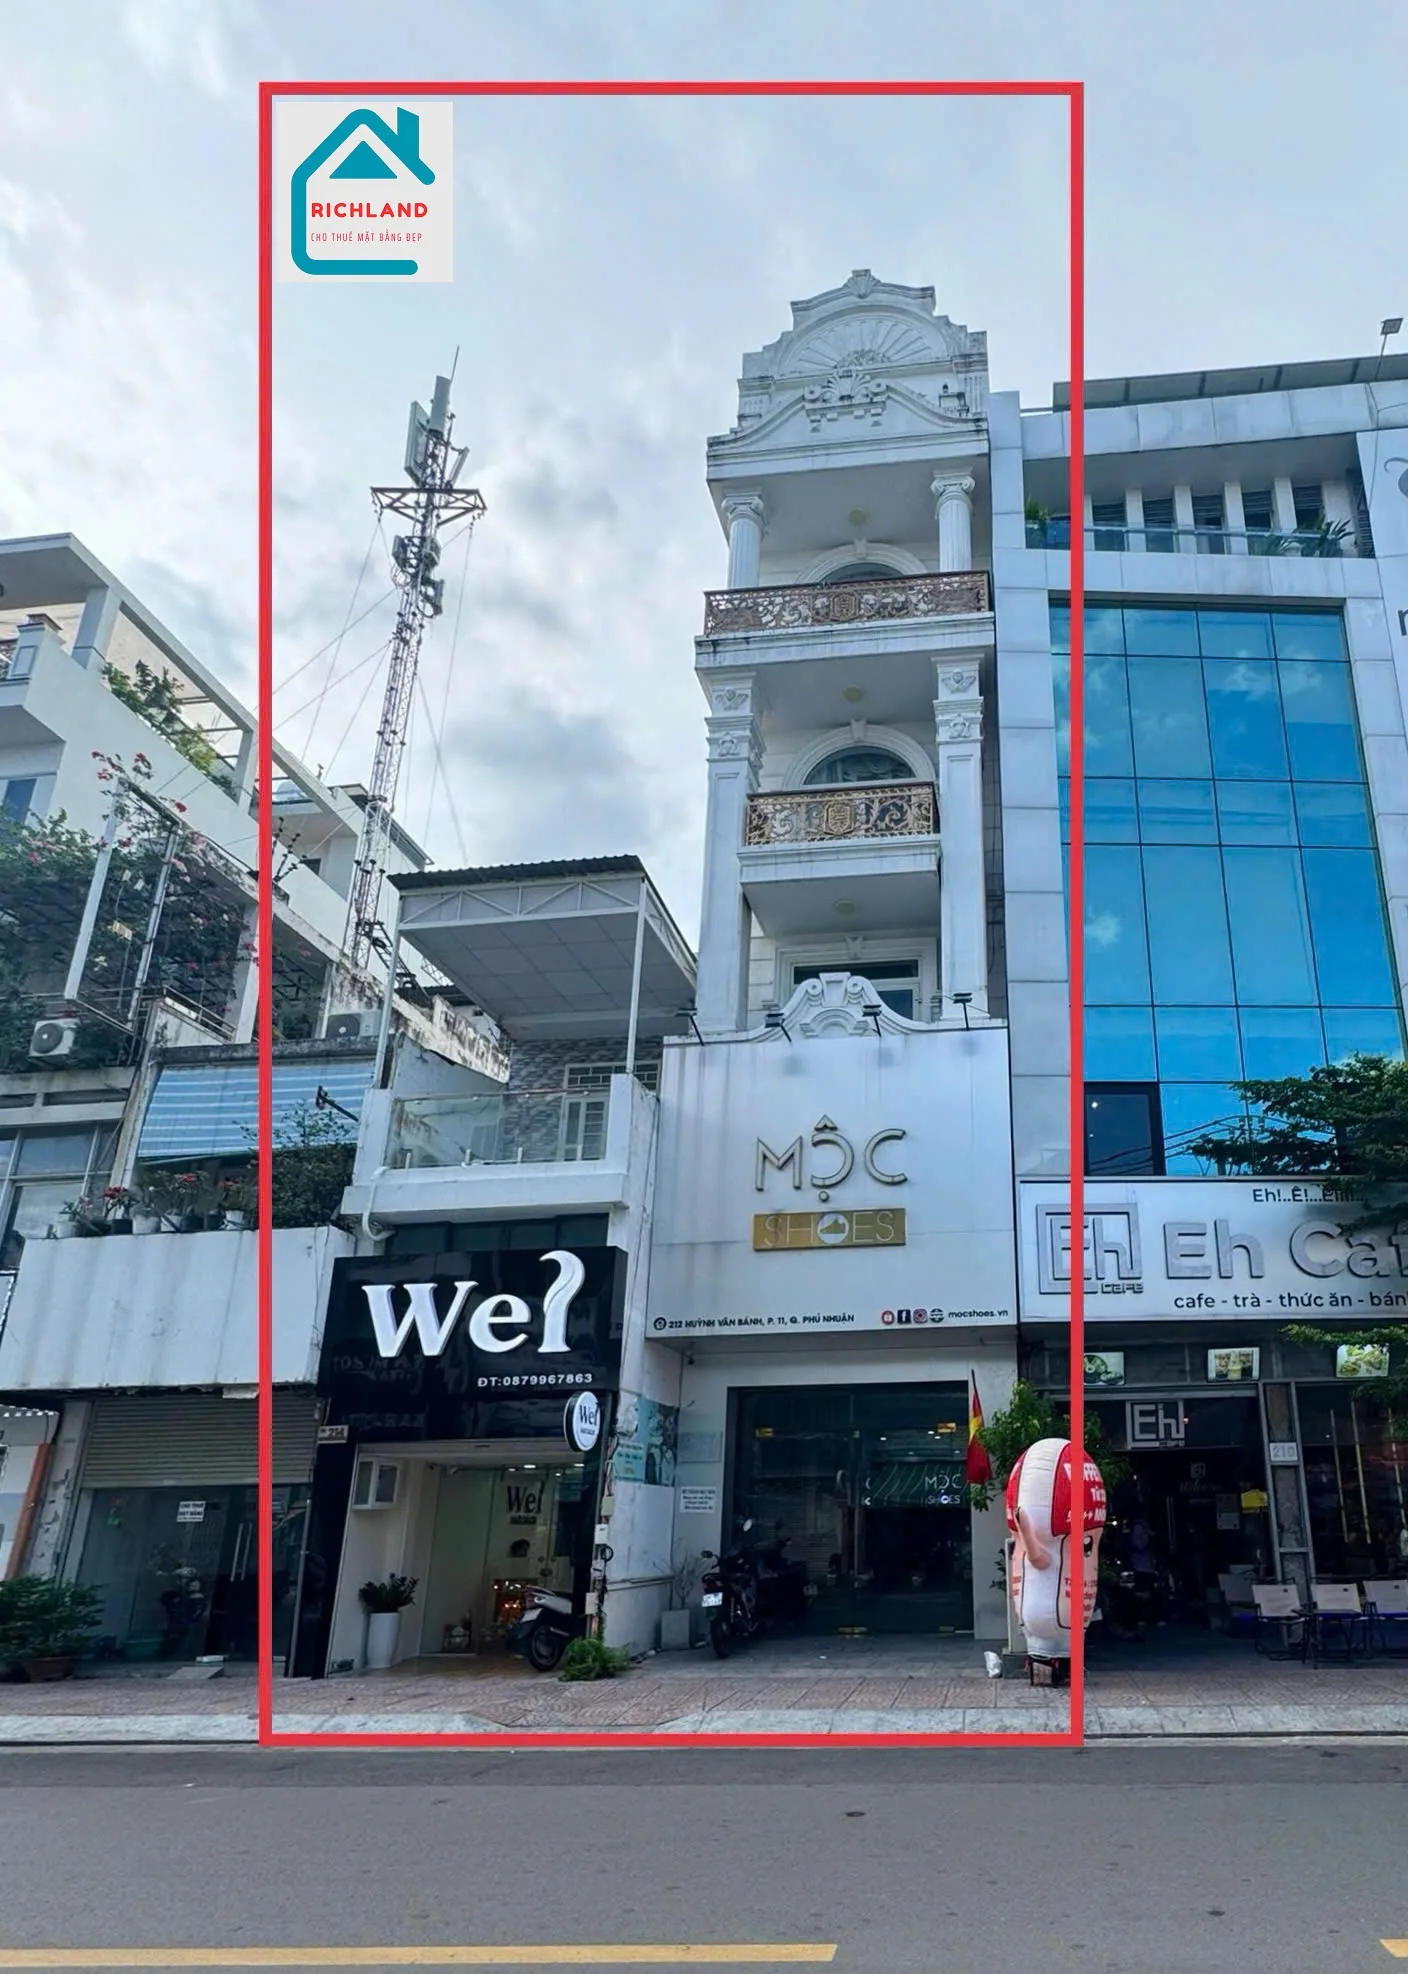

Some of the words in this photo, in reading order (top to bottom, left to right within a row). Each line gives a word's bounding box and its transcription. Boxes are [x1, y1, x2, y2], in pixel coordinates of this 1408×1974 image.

[755, 1114, 908, 1202] MỘC
[1163, 1218, 1265, 1280] Eh
[361, 1250, 586, 1358] Wel
[1174, 1293, 1216, 1309] cafe
[1233, 1292, 1261, 1308] trà
[1279, 1292, 1325, 1308] thức
[1329, 1292, 1353, 1307] ăn
[1369, 1291, 1408, 1307] bán
[717, 1316, 736, 1327] VĂN
[737, 1315, 765, 1327] BÁNH,
[802, 1312, 820, 1324] PHÚ
[822, 1312, 855, 1325] NHUẬN
[948, 1309, 1008, 1319] mocshoes.vn
[477, 1373, 593, 1388] ĐT:0879967863
